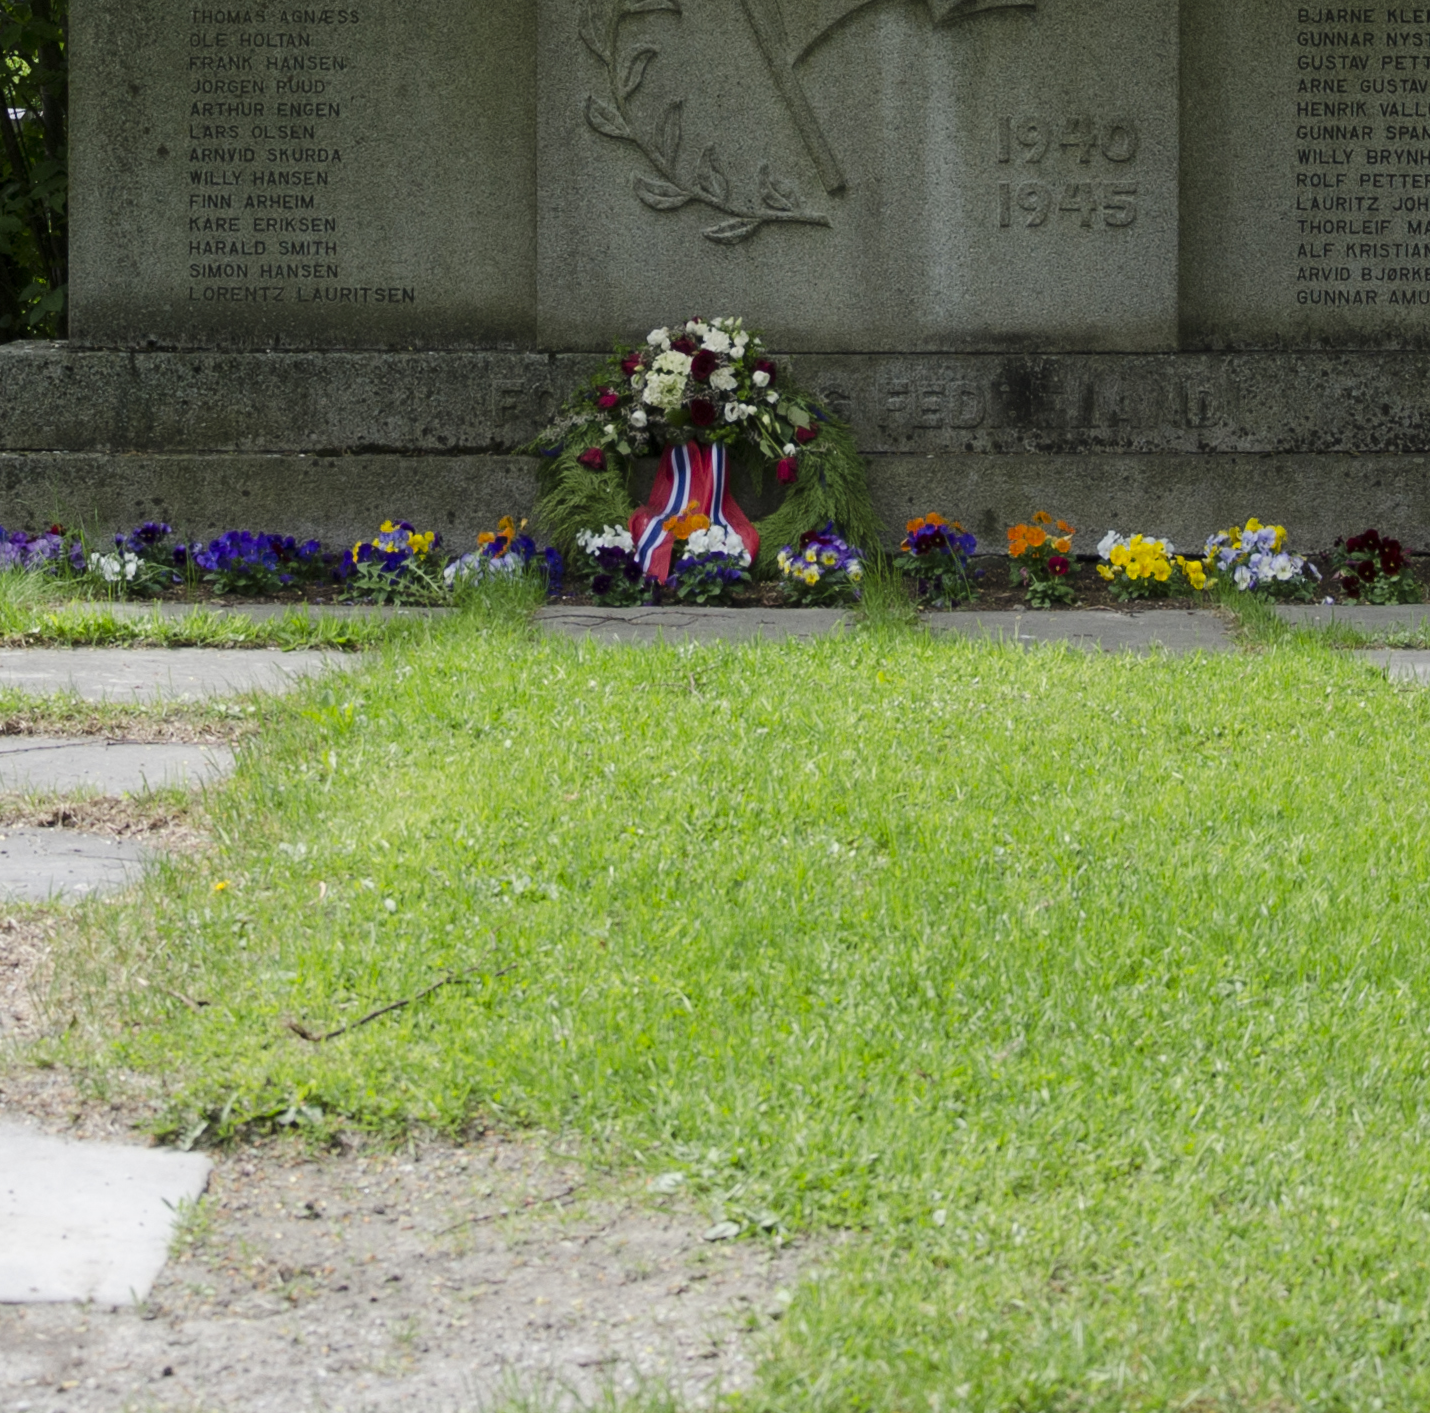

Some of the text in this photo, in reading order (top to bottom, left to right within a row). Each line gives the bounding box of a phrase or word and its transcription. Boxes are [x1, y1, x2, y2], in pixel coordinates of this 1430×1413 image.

[190, 10, 267, 25] THOMAS
[1297, 8, 1375, 24] BJARNE
[189, 33, 311, 49] OLE HOLTAN
[1296, 32, 1375, 48] GUNNAR
[189, 56, 346, 71] FRANK HANSEN
[1297, 55, 1370, 71] GUSTAV
[276, 79, 327, 95] RUUD
[1297, 78, 1348, 95] ARNE
[190, 102, 341, 118] ARTHUR ENGEN
[1296, 102, 1367, 118] HENRIK
[189, 125, 316, 140] LARS OLSEN
[997, 115, 1139, 164] 1940
[1296, 126, 1374, 142] GUNNAR
[188, 147, 342, 164] ARNVID SKURDA
[1297, 149, 1355, 165] WILLY
[189, 171, 329, 186] WILLY HANSEN
[1296, 173, 1347, 189] ROLF
[188, 194, 233, 210] FINN
[997, 180, 1139, 228] 1945
[1295, 196, 1381, 213] LAURITZ
[253, 217, 337, 233] ERIKSEN
[1297, 219, 1392, 235] THORLEIF
[188, 240, 338, 256] HARALD SMITH
[1297, 243, 1336, 259] ALF
[189, 263, 339, 279] SIMON HANSEN
[1296, 266, 1351, 282] ARVID
[189, 287, 416, 304] LORENTZ LAURITSEN
[1296, 290, 1378, 305] GUNNAR
